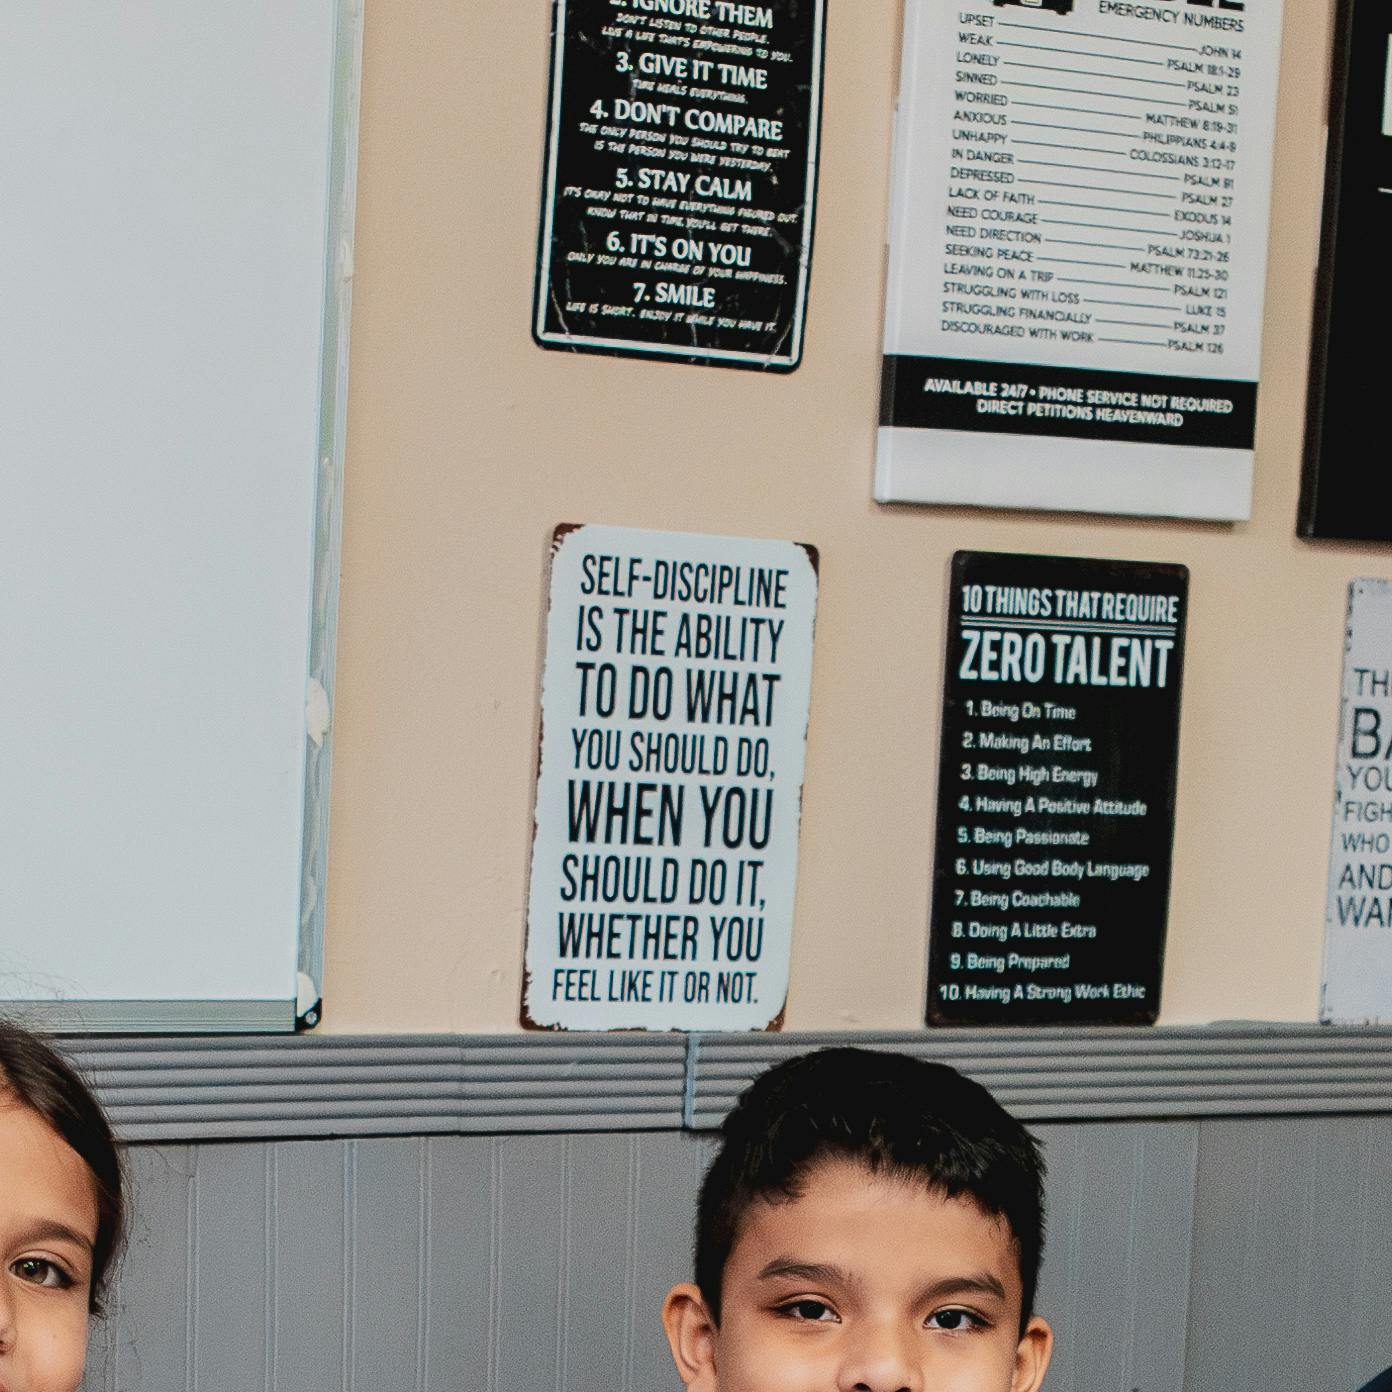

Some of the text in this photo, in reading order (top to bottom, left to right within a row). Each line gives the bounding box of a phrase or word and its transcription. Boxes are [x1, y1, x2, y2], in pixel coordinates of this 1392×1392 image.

[715, 1, 773, 29] THEM
[1099, 0, 1244, 33] EMERGENCY NUMBERS
[615, 51, 768, 90] 3. GIVE IT TIME
[955, 90, 1008, 106] WORRIED
[589, 99, 783, 141] 4. DON'T COMPARE
[615, 167, 752, 201] 5. STAY CALM
[950, 166, 1015, 184] DEPRESSED
[606, 230, 752, 267] 6. IT'S ON YOU
[633, 282, 715, 308] 7. SMILE
[976, 398, 1184, 427] DIRECT PETITIONS HEAVENWARD
[581, 555, 788, 608] SELF-DISCIPLINE
[962, 584, 1179, 623] 10 THINGS THAT REQUIRE
[576, 605, 784, 663] IS THE ABILITY
[960, 630, 1173, 687] ZERO TALENT
[576, 661, 780, 726] TO DO WHAT
[967, 700, 1076, 722] 1. Being On Time
[572, 728, 775, 781] YOU SHOULD DO,
[962, 731, 1092, 754] 2. Making An Effort
[568, 780, 773, 850] WHEN YOU
[1341, 833, 1390, 854] WHO
[560, 854, 765, 910] SHOULD DO IT,
[559, 912, 764, 962] WHETHER YOU
[552, 968, 758, 1004] FEEL LIKE IT OR NOT.
